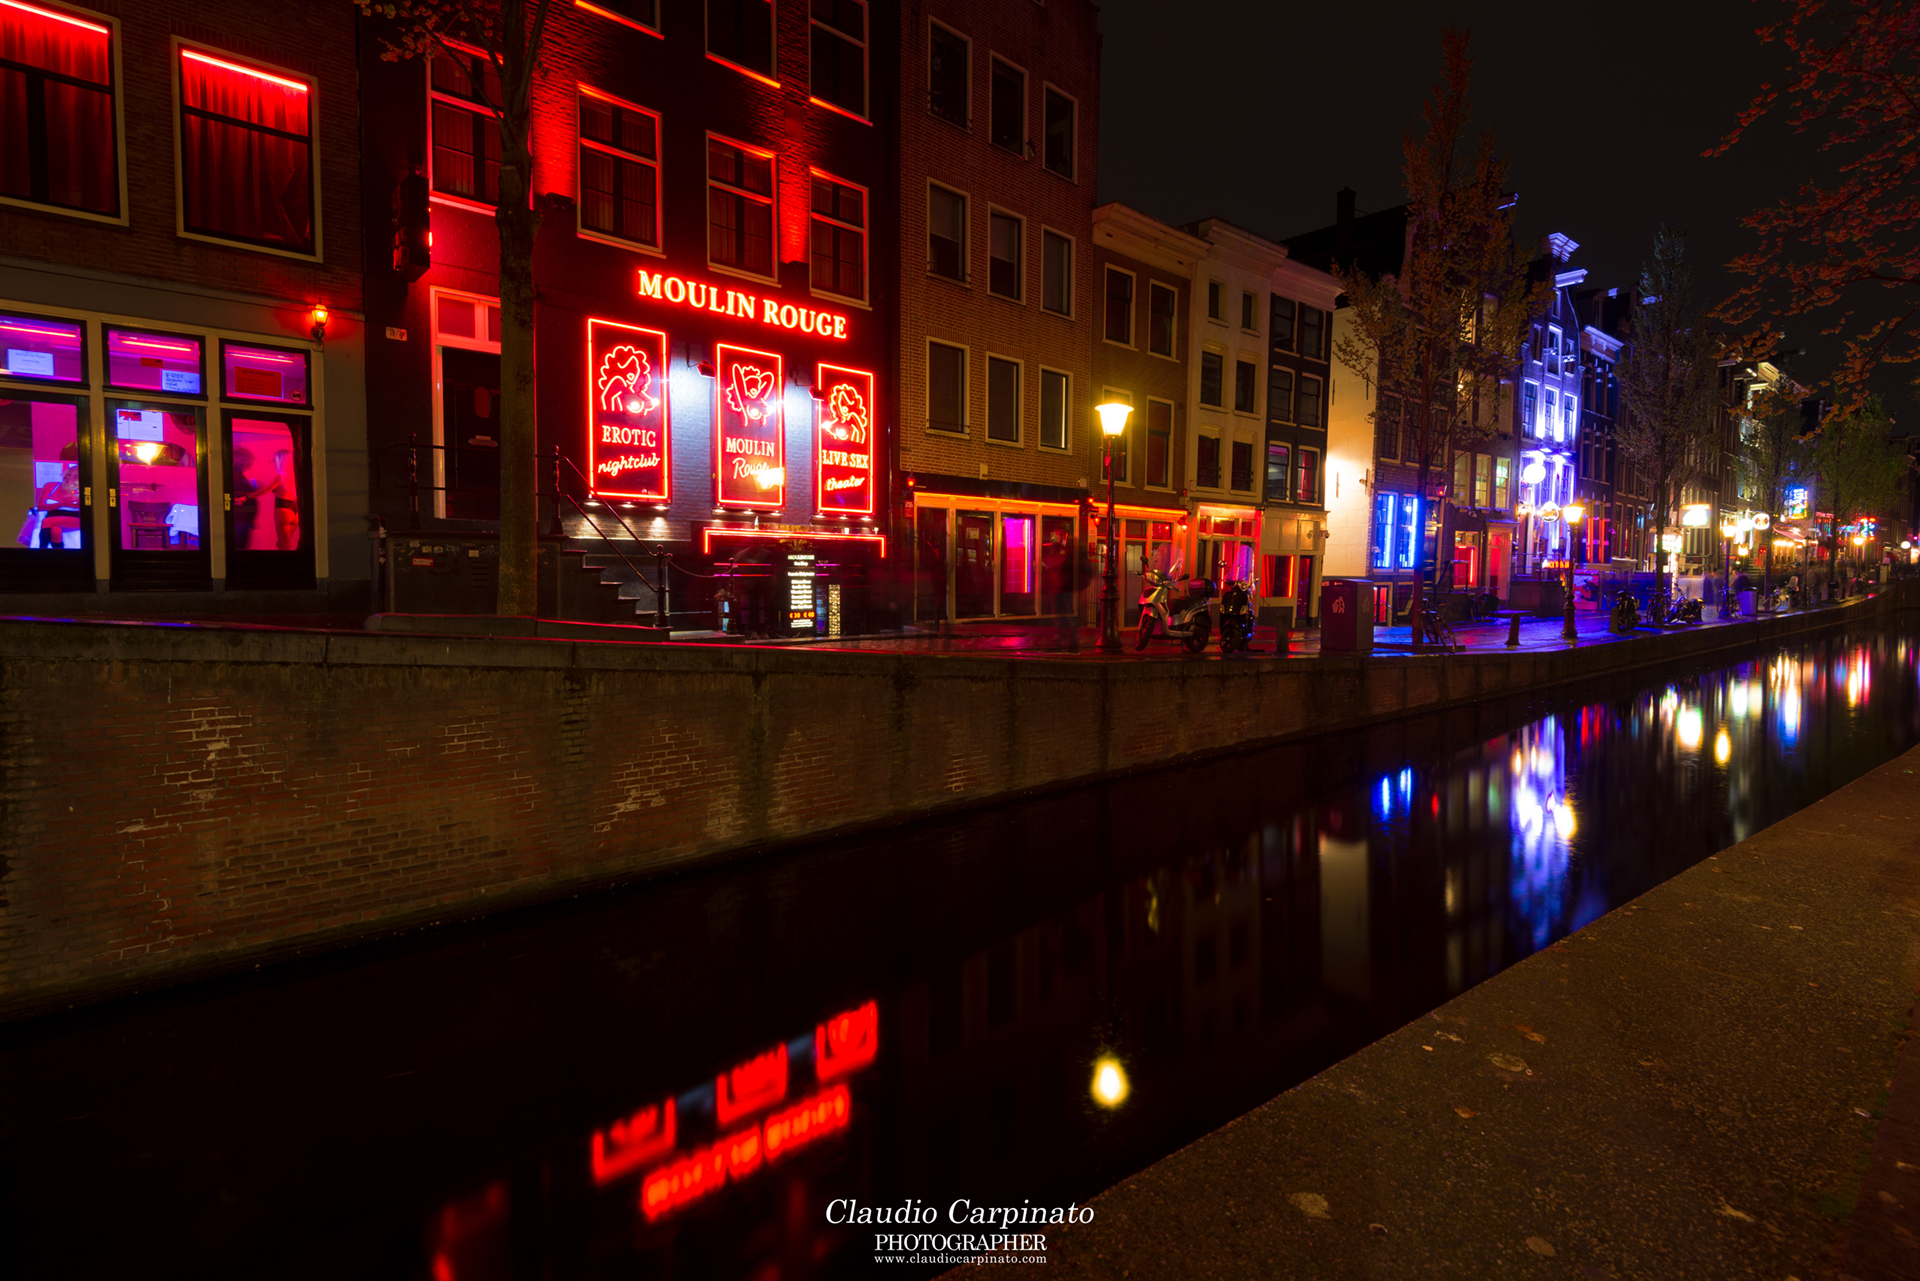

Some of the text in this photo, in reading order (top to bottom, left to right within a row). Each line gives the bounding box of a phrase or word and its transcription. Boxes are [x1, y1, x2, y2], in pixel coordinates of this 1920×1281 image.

[637, 269, 847, 339] MOULIN ROUGE
[601, 424, 656, 447] EROTIC
[725, 437, 775, 457] MOULIN
[598, 452, 661, 477] nightclub
[732, 457, 770, 482] Rouge
[822, 449, 869, 469] LIVE SEX
[824, 475, 866, 491] theater
